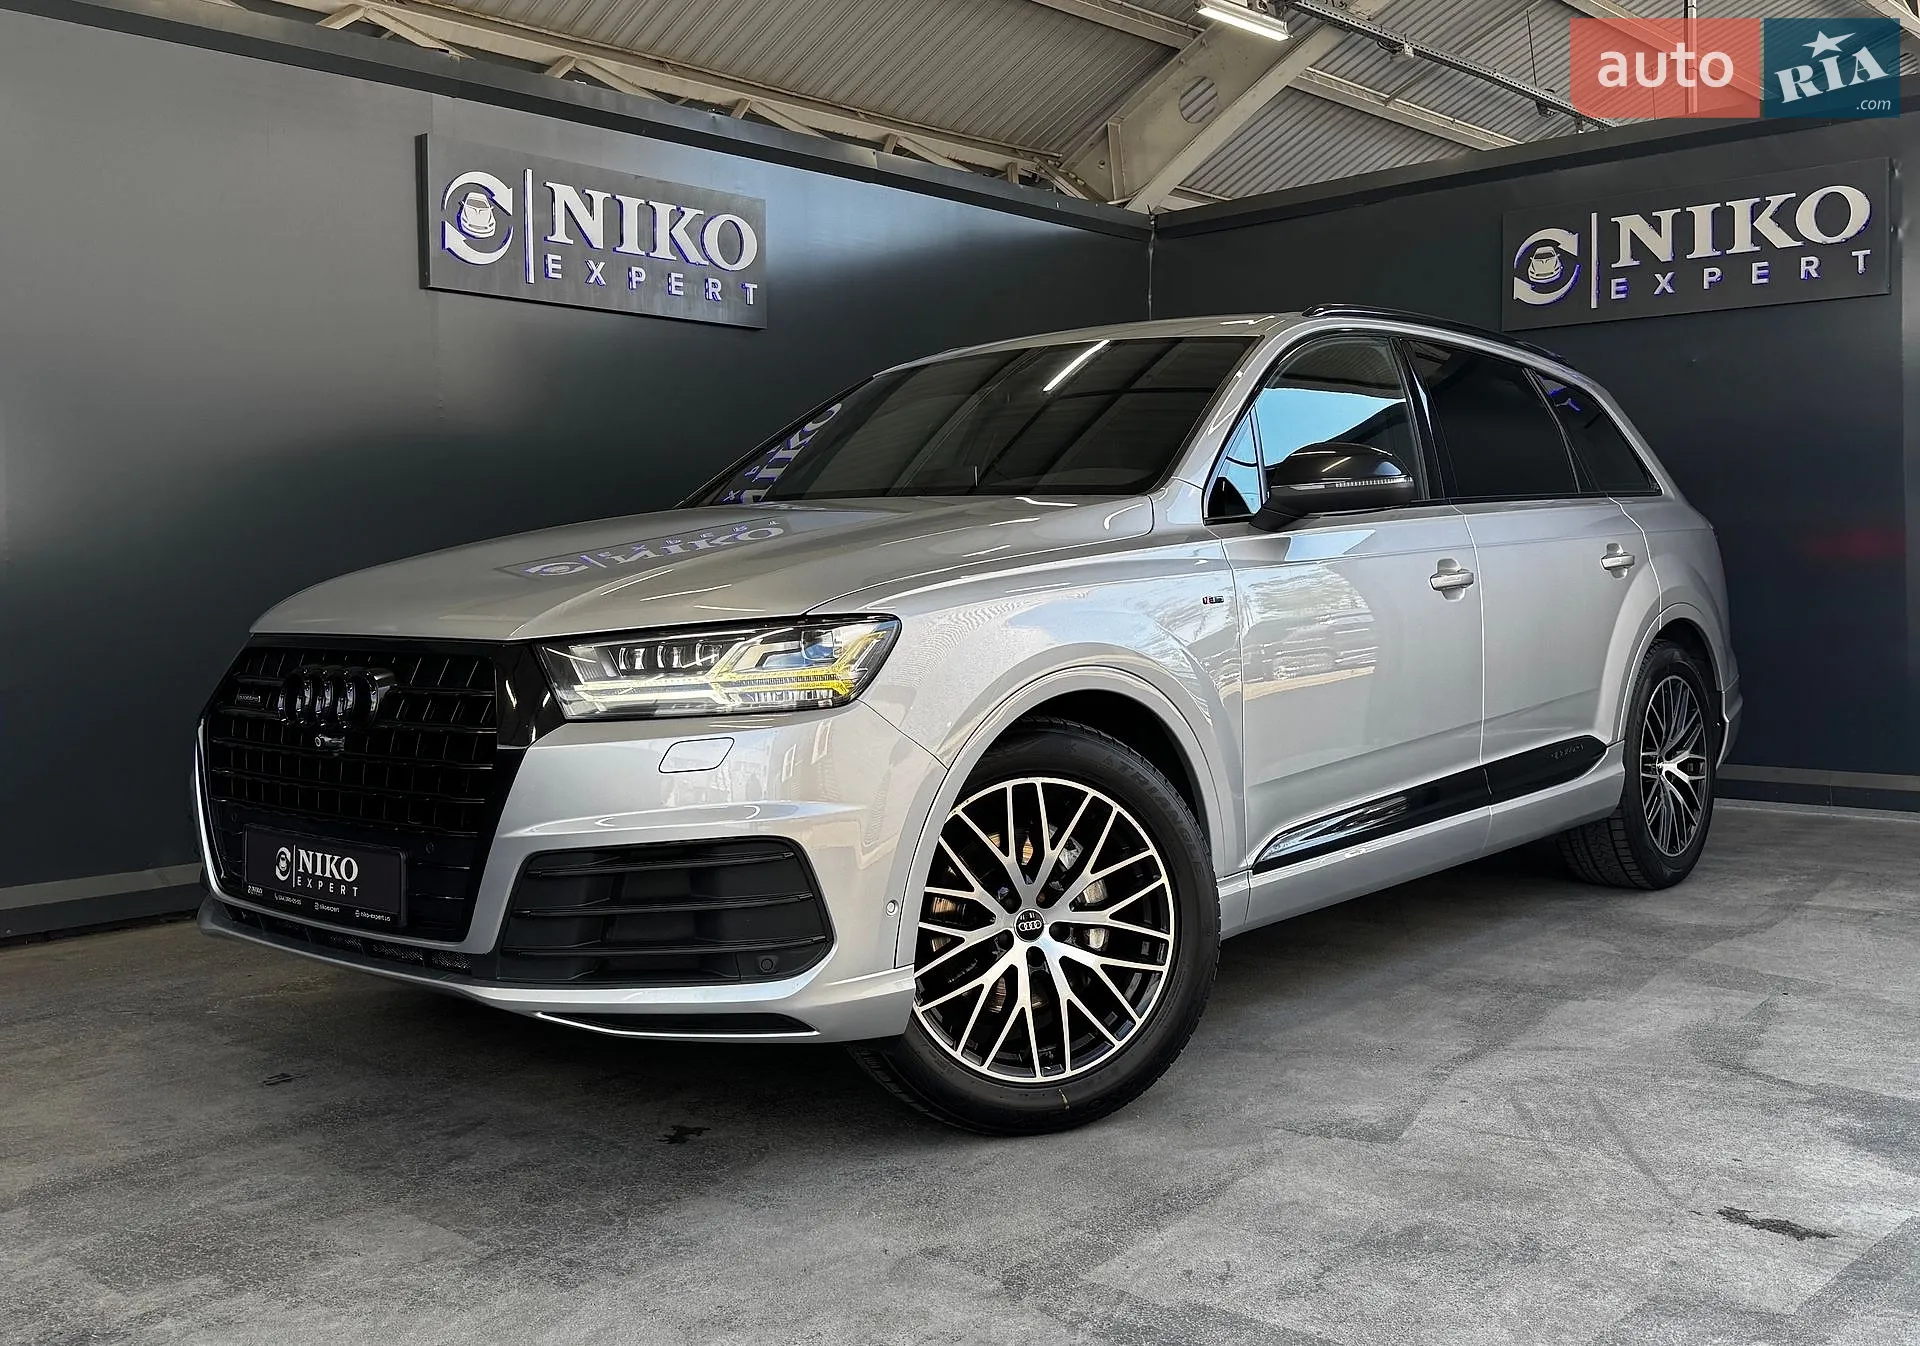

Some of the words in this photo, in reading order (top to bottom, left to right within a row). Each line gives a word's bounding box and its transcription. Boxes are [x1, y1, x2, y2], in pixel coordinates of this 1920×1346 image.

[543, 180, 758, 272] NIKO
[1610, 185, 1872, 269] NIKO
[544, 253, 758, 305] EXPERT
[1610, 249, 1872, 300] EXPERT
[297, 849, 359, 882] NIKO
[297, 876, 359, 897] EXPERT
